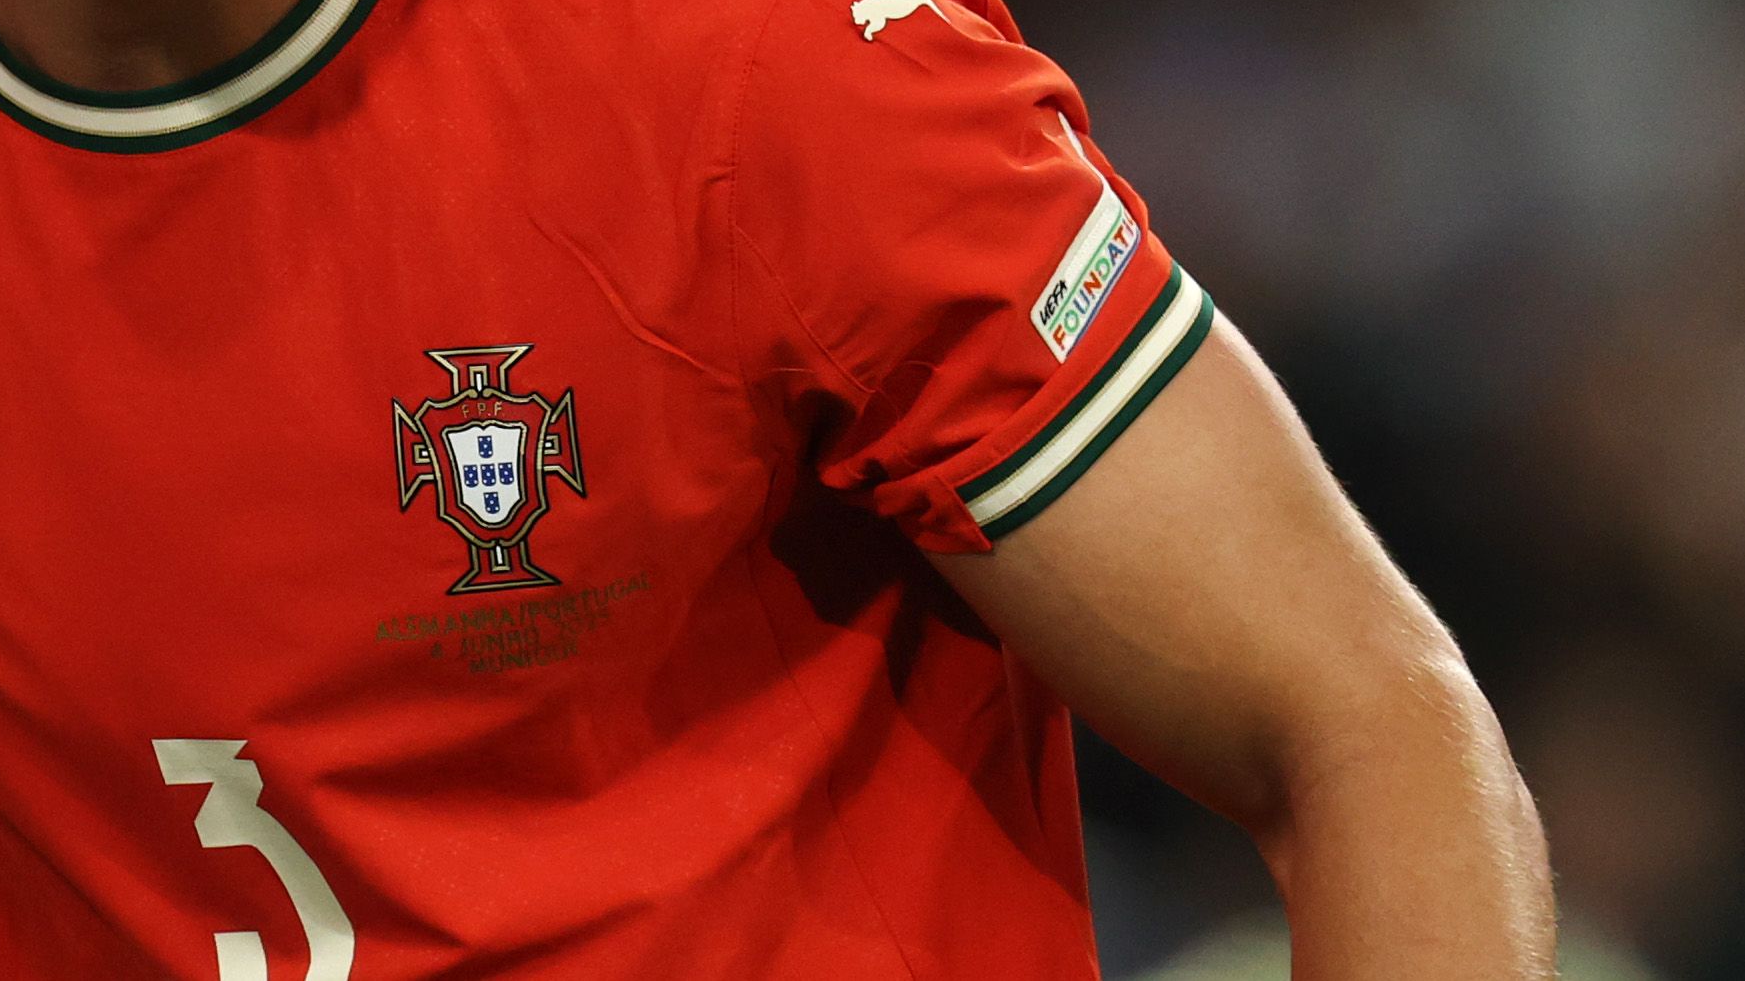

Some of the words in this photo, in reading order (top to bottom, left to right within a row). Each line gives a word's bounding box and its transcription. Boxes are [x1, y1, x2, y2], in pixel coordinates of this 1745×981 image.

[1039, 280, 1068, 326] UEFA
[1052, 211, 1135, 351] FOUNDATI
[151, 738, 355, 981] 3
